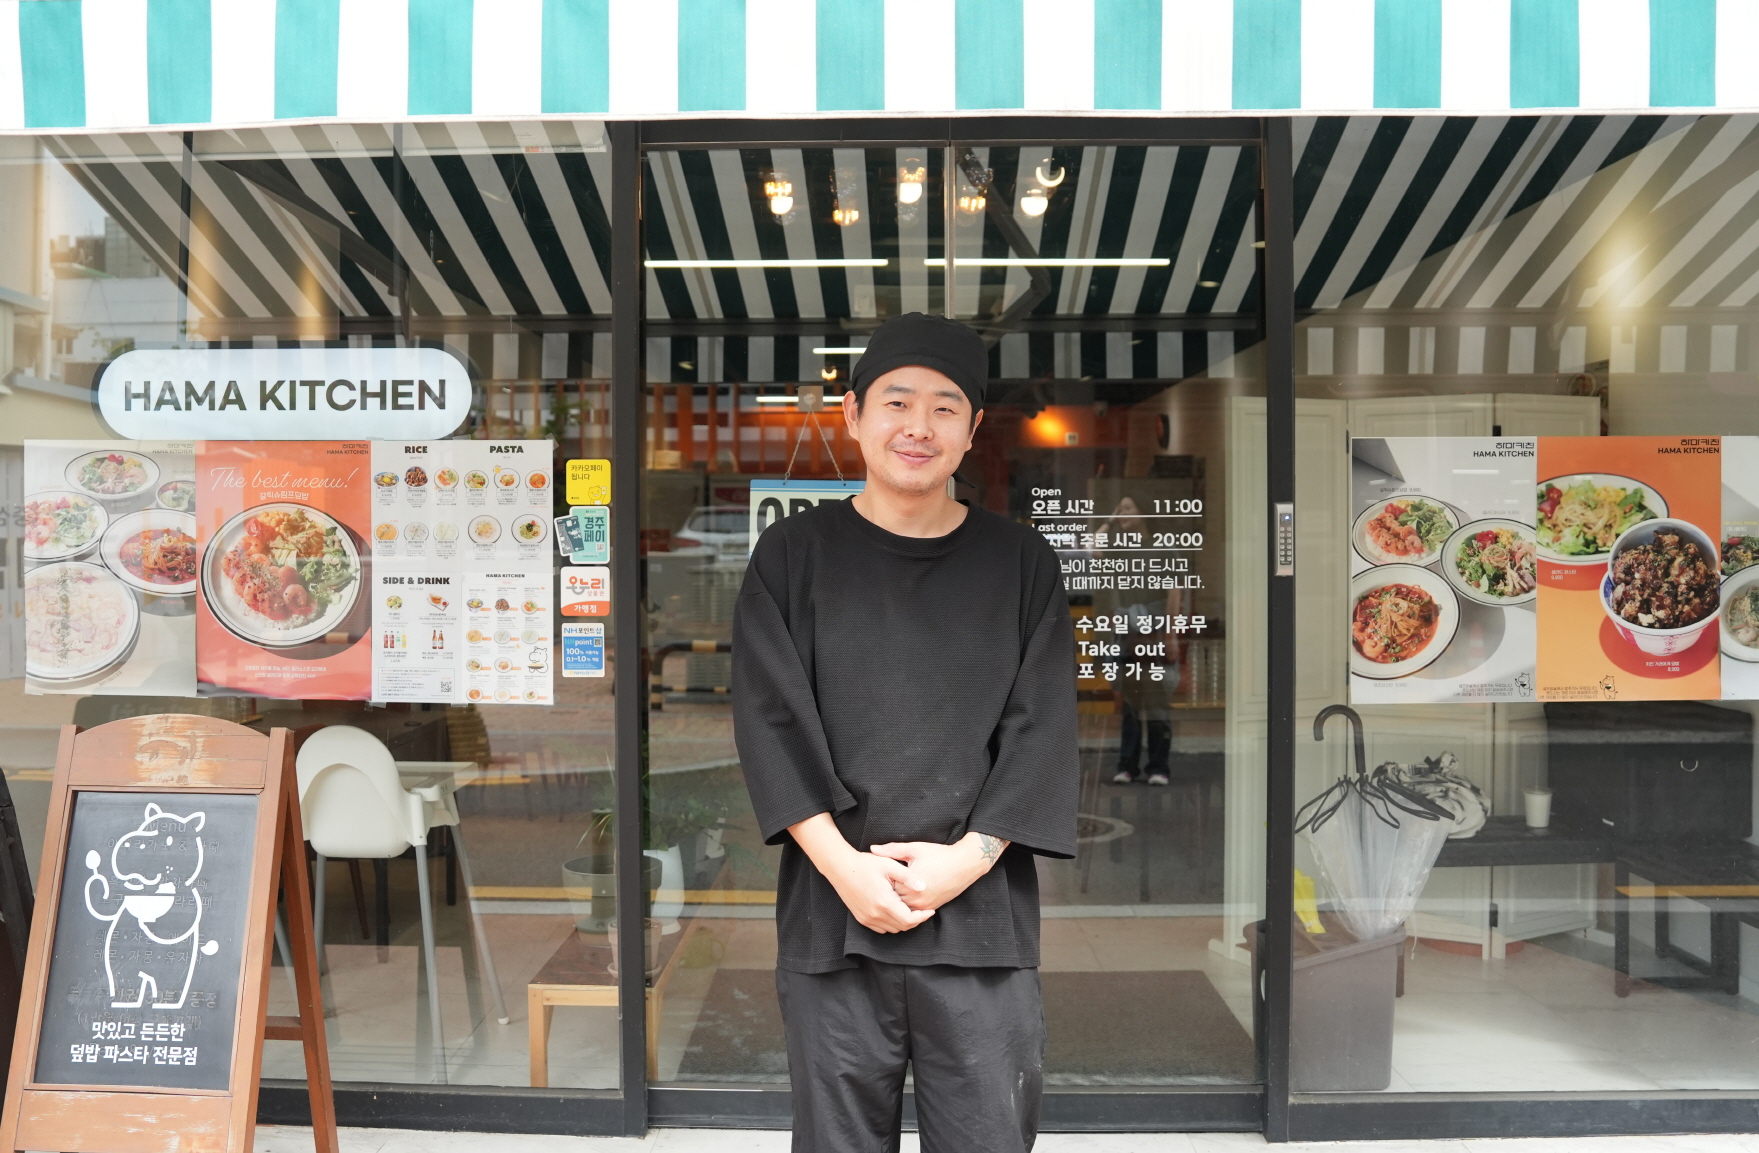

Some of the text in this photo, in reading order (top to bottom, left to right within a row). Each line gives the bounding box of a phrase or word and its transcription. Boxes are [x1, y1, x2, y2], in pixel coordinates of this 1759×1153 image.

[123, 378, 446, 411] HAMA KITCHEN
[404, 445, 428, 454] RICE
[489, 445, 524, 454] PASTA
[571, 464, 602, 472] 카카오페이
[210, 466, 247, 491] The
[251, 469, 293, 489] best
[291, 467, 359, 489] menu!
[259, 490, 310, 500] 갈릭슈림프덮밥
[1031, 487, 1061, 498] Open
[1031, 499, 1203, 514] 오픈 시간 11:00
[584, 517, 605, 529] 경주
[1057, 523, 1087, 532] order
[584, 530, 605, 543] 페이
[1042, 532, 1203, 547] 지막 주문 시간 20:00
[1059, 558, 1188, 573] 님이 천천히 다 드시고
[382, 576, 450, 585] SIDE & DRINK
[1072, 576, 1114, 590] 때까지
[1117, 575, 1144, 589] 닫지
[1147, 575, 1205, 590] 않습니다.
[574, 604, 597, 613] 가맹점
[1076, 614, 1207, 635] 수요일 정기휴무
[1078, 641, 1166, 656] Take out
[91, 1021, 186, 1042] 맛있고 든든한
[70, 1043, 198, 1066] 덮밥 파스타 전문점
